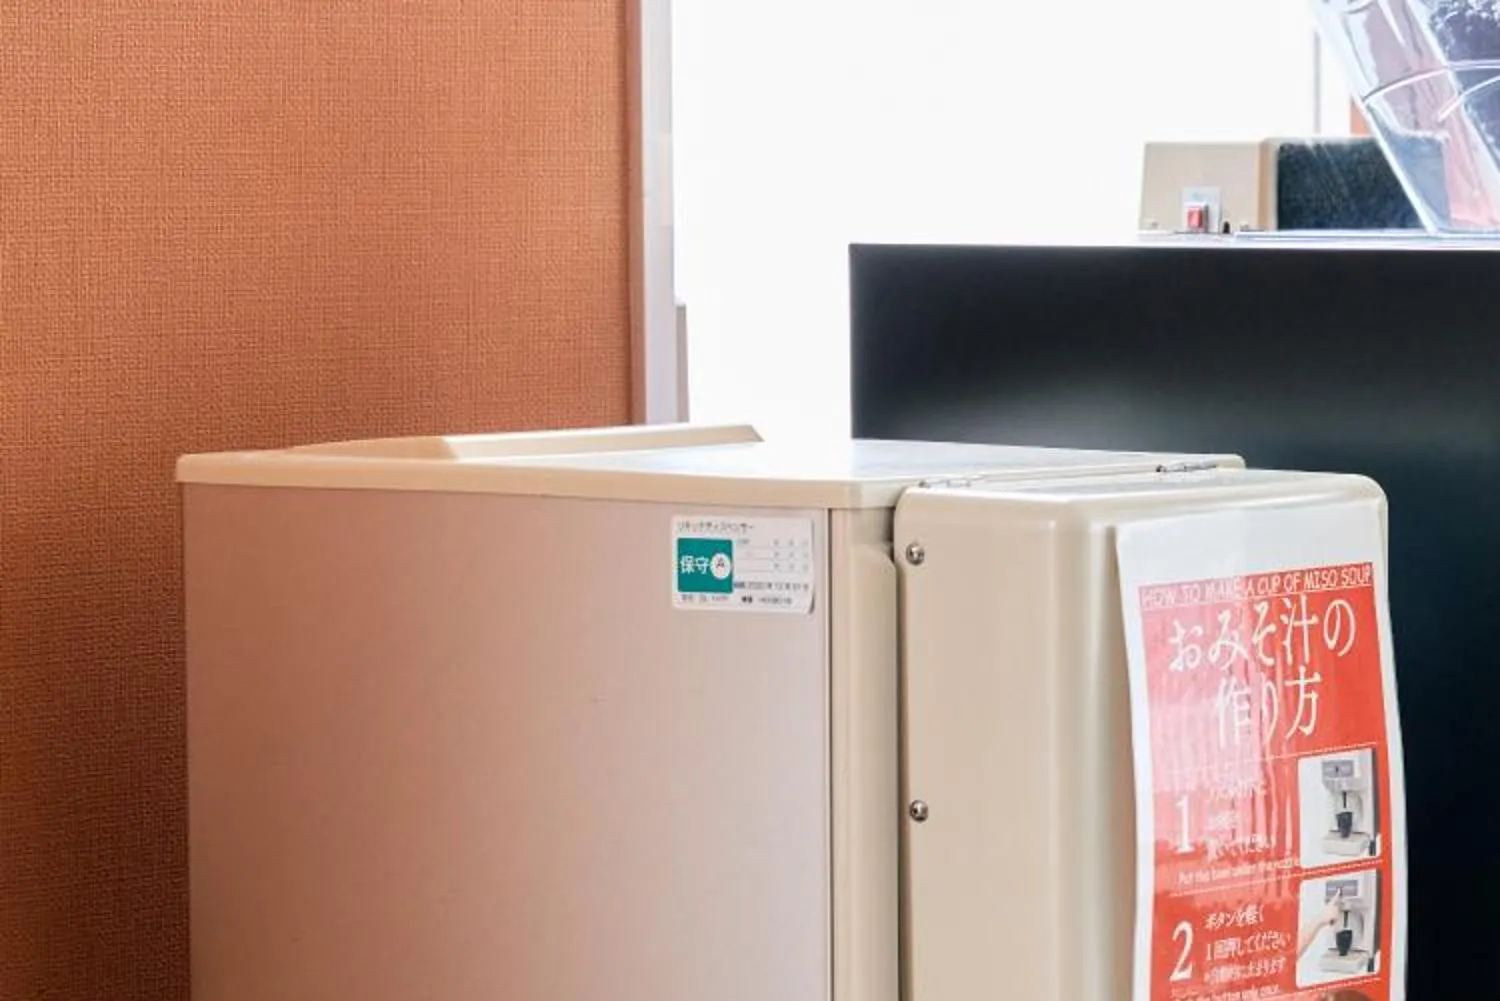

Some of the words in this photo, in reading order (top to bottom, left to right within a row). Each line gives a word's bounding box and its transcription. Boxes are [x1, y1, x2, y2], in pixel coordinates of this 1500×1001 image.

[680, 555, 709, 574] 保守
[1142, 586, 1174, 607] HOW
[1180, 583, 1200, 602] TO
[1205, 579, 1245, 601] MAKE
[1246, 578, 1256, 597] A
[1257, 574, 1280, 595] CUP
[1283, 572, 1301, 593] OF
[1303, 568, 1337, 590] MISO
[1341, 564, 1371, 586] SOUP
[1168, 594, 1356, 672] おみそ汁の
[1217, 665, 1323, 747] 作り方
[1175, 794, 1196, 854] 1
[1169, 920, 1194, 982] 2
